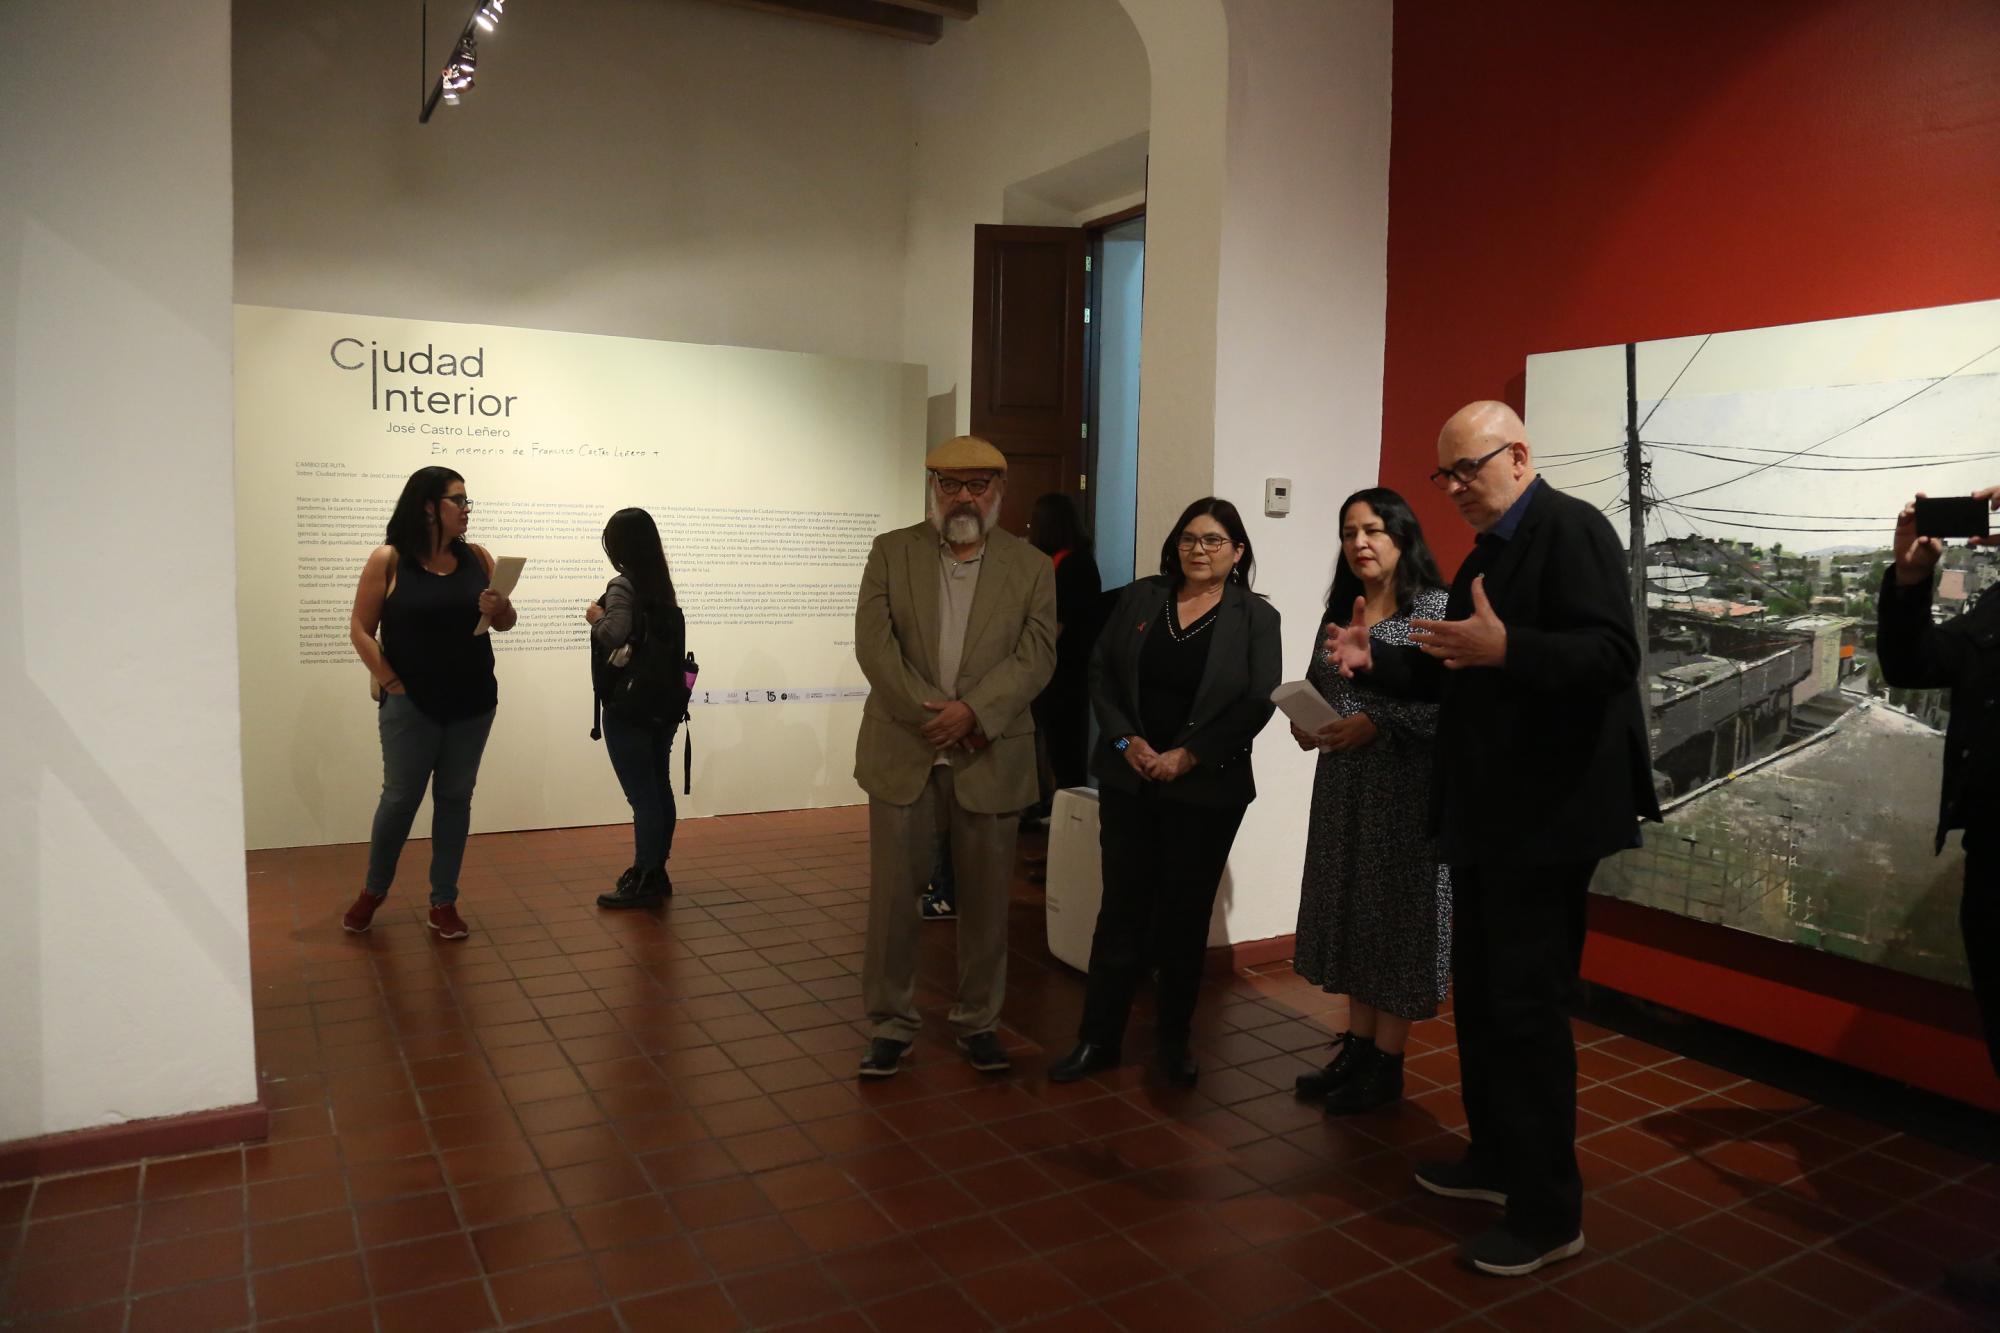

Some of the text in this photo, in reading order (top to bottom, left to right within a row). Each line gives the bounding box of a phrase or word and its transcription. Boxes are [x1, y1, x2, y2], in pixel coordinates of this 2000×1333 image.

[330, 337, 484, 379] Ciudad
[371, 384, 518, 417] Interior
[386, 422, 510, 438] José Castro Leñero
[431, 442, 448, 455] En
